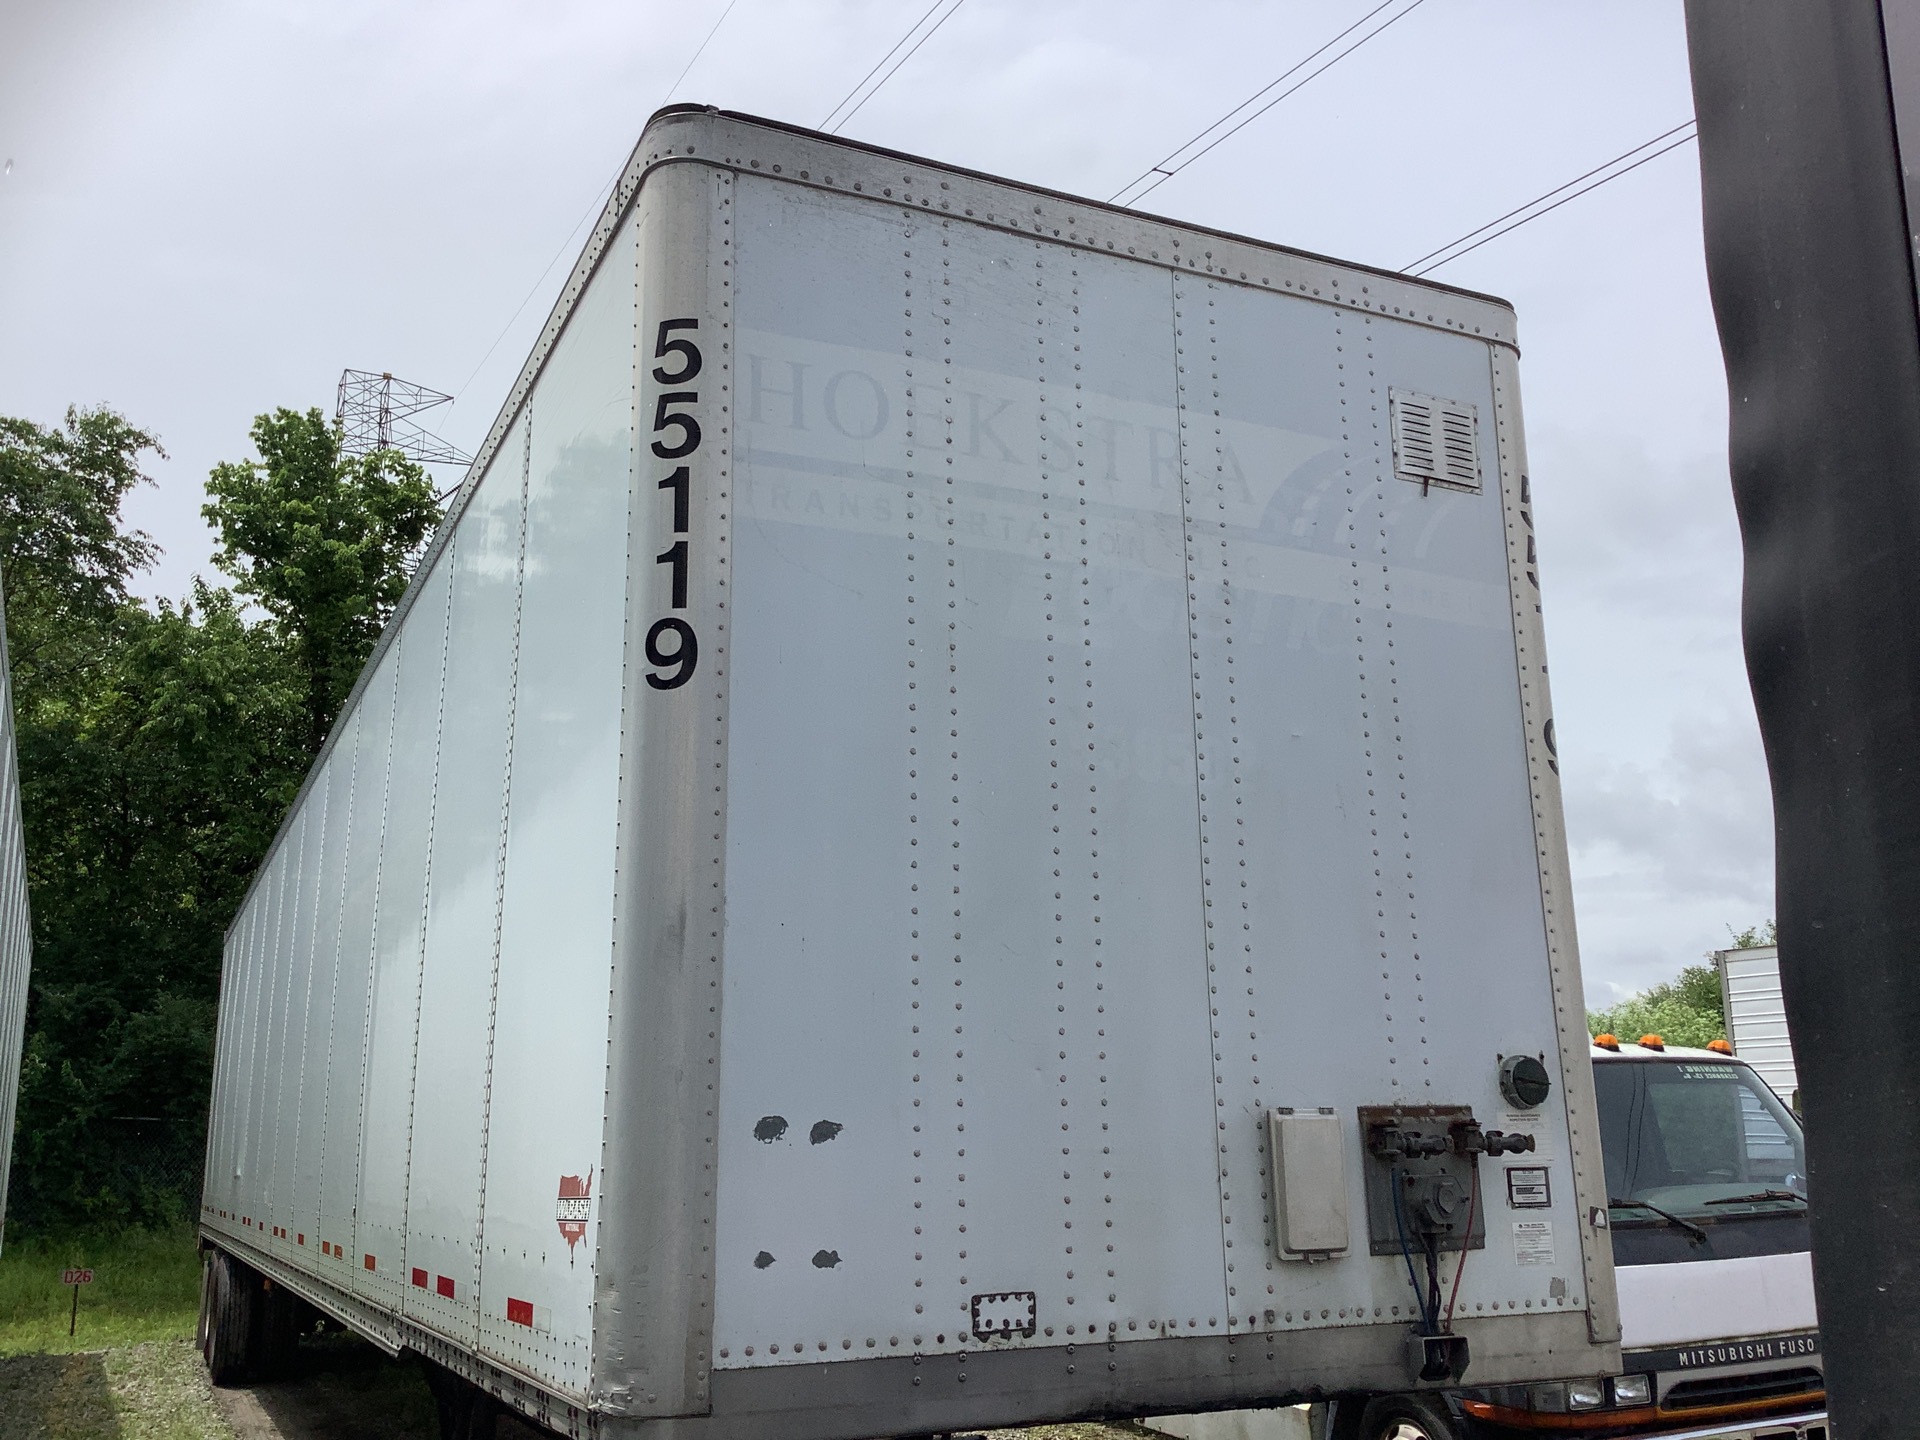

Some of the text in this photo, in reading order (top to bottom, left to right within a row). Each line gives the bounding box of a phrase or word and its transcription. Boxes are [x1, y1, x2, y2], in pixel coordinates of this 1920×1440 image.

[645, 318, 703, 691] 55119
[748, 353, 1258, 506] HOEKSTRA
[1679, 1338, 1815, 1366] MITSUBISHI FUSO
